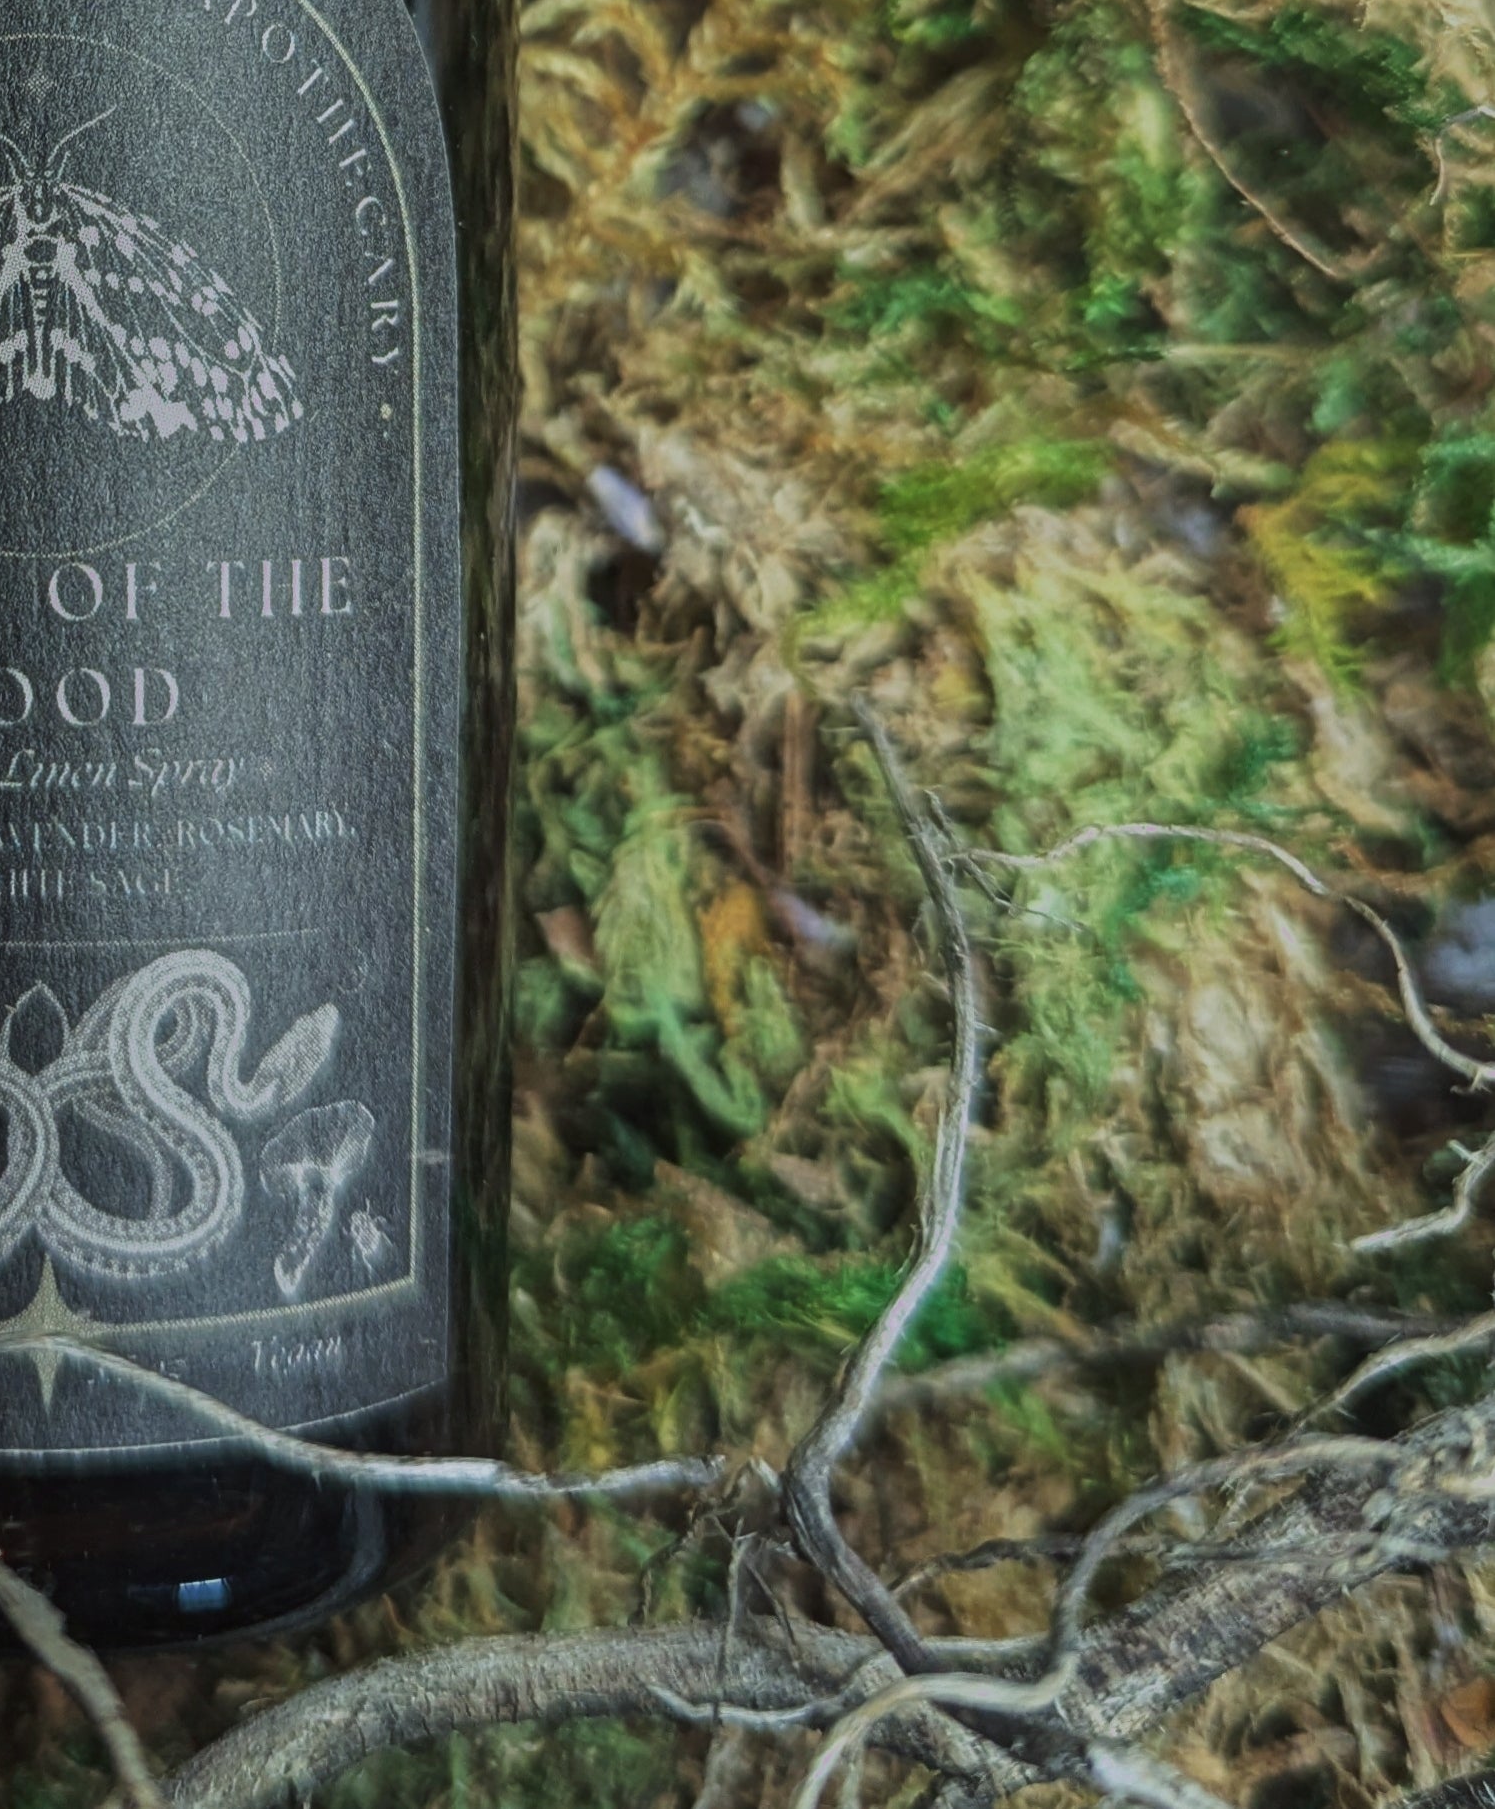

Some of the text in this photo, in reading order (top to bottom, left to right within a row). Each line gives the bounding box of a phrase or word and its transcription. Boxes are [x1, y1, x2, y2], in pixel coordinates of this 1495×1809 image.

[49, 561, 161, 621] OF
[206, 557, 351, 618] THE
[0, 748, 118, 788] Linen
[127, 747, 245, 797] Spray
[90, 867, 174, 897] SAGE
